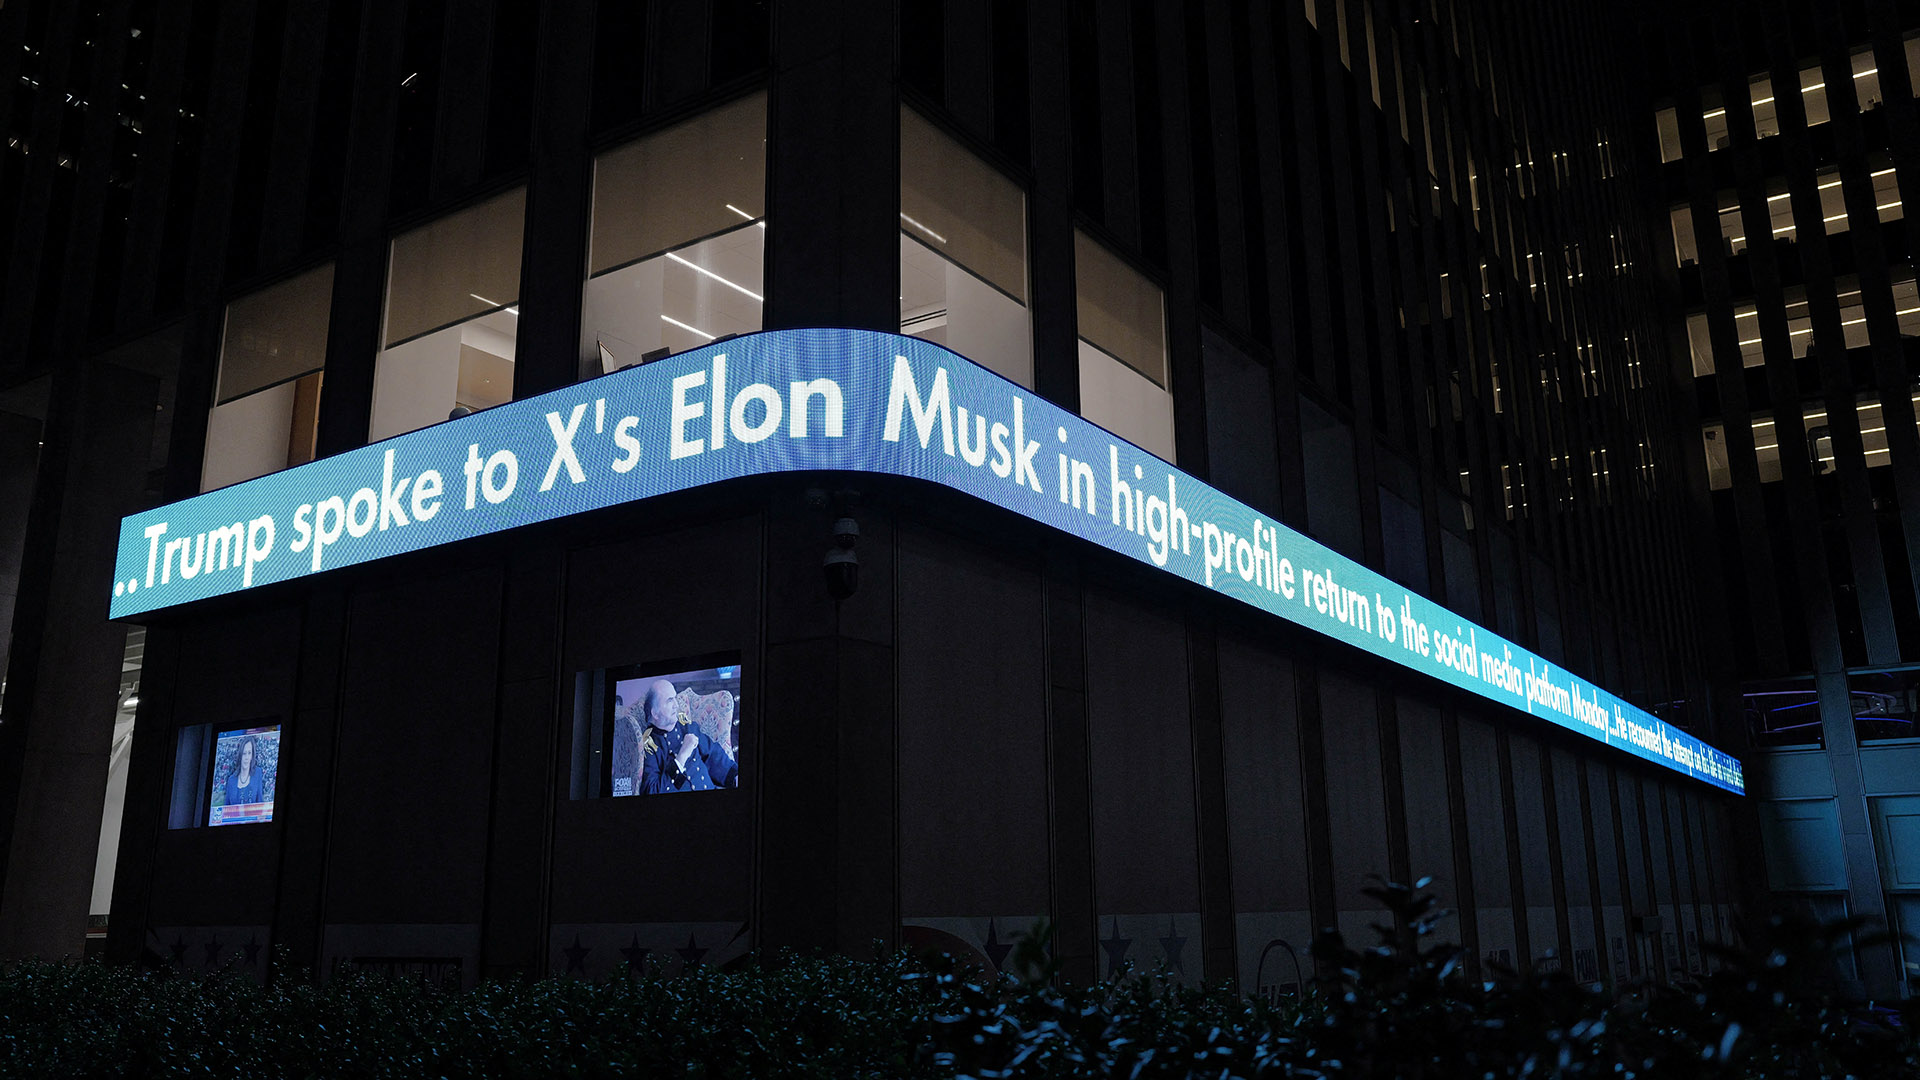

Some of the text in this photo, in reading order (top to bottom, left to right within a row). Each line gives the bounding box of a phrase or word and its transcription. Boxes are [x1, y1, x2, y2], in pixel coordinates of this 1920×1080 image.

[289, 449, 444, 573] spoke
[463, 440, 519, 511] to
[538, 397, 642, 493] X's
[669, 353, 844, 461] Elon
[882, 354, 1044, 494] Musk
[1057, 426, 1097, 516] in
[1108, 443, 1296, 601] high-profile
[1301, 567, 1372, 634] return
[1375, 592, 1397, 644] to
[1400, 594, 1430, 658] the
[1433, 626, 1479, 678] social
[1480, 644, 1524, 697] media
[1524, 657, 1572, 716] platform
[1627, 720, 1663, 755] recounted
[1661, 724, 1673, 759] the
[1672, 737, 1695, 776] attempt
